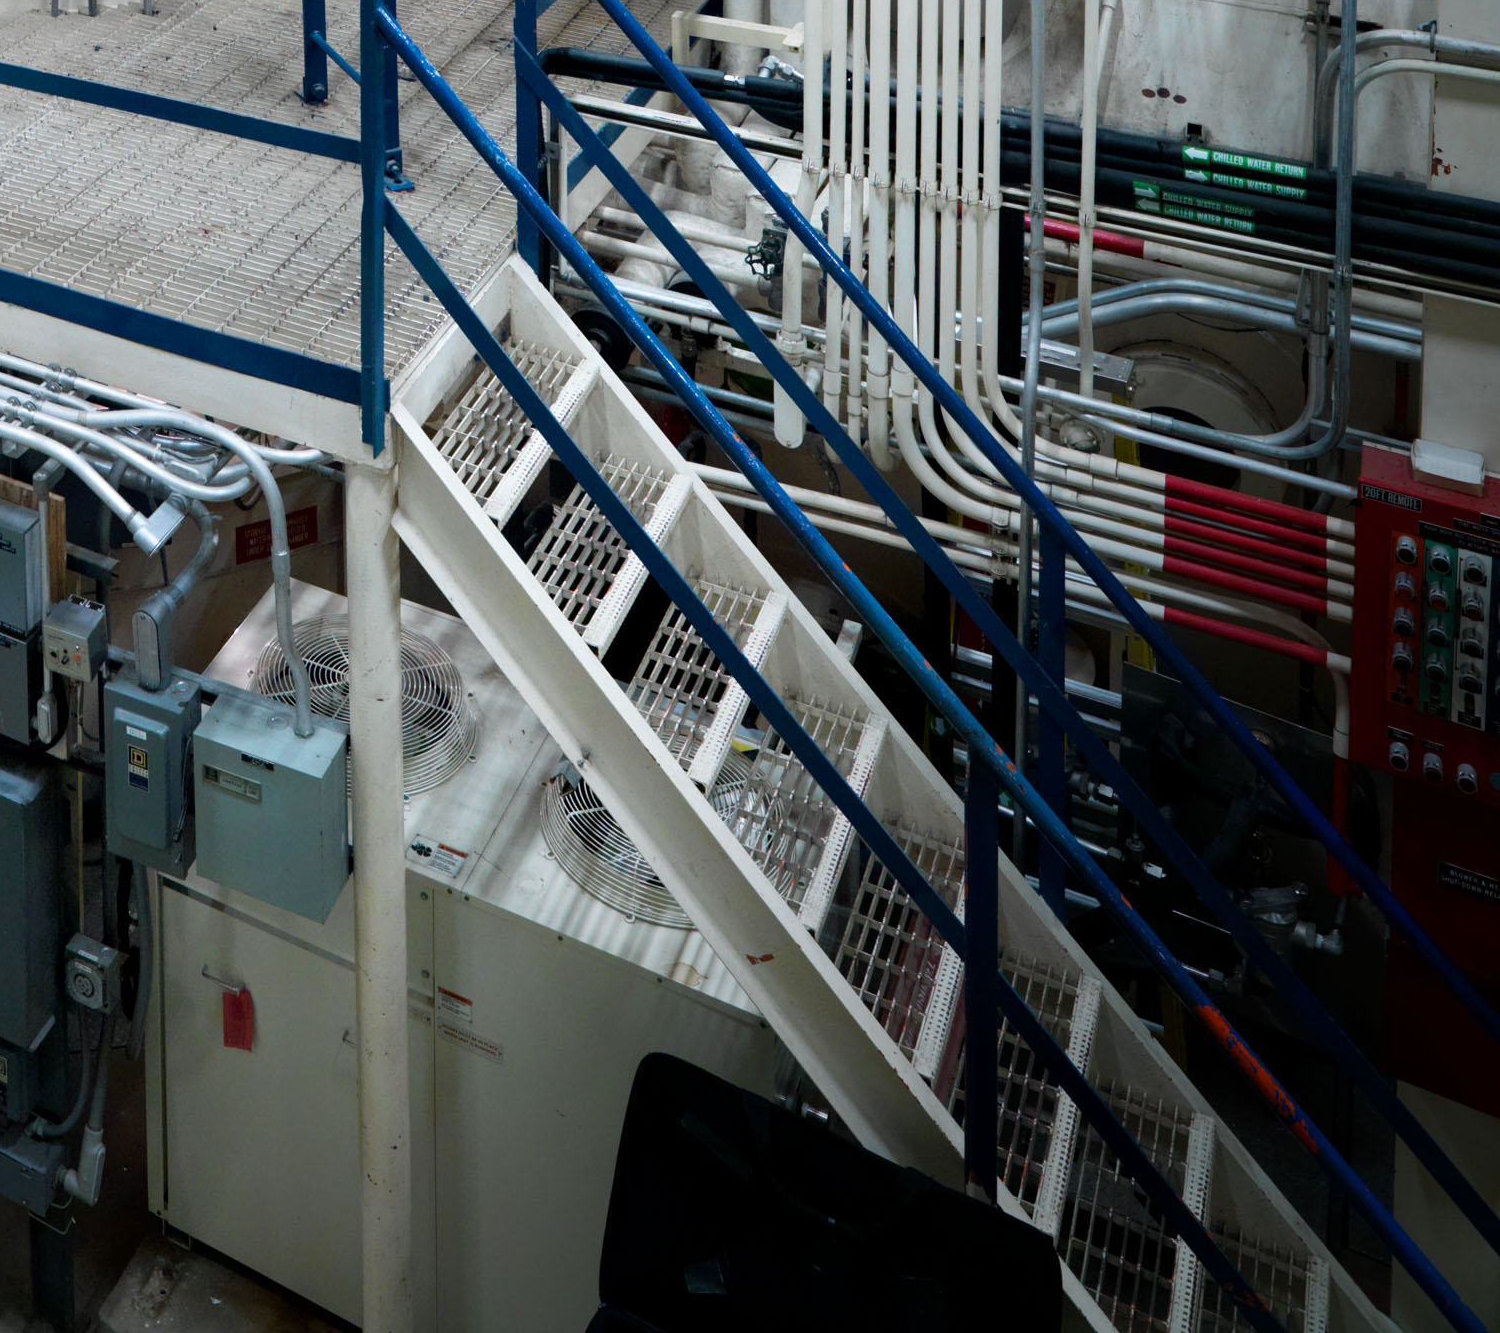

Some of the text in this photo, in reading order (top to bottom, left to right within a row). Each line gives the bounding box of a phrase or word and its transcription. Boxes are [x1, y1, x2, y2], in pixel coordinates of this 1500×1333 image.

[1213, 151, 1304, 177] CHILLED WATER RETURN
[1212, 173, 1305, 199] CHILLED WATER SUPPLY
[1162, 191, 1254, 217] CHILLED WATER SUPPLY
[1163, 204, 1253, 231] CHILLED WATER RETURN
[1388, 492, 1419, 510] REMOTE
[1439, 872, 1483, 894] SHUT-DOWN
[1448, 868, 1478, 883] BLOWER
